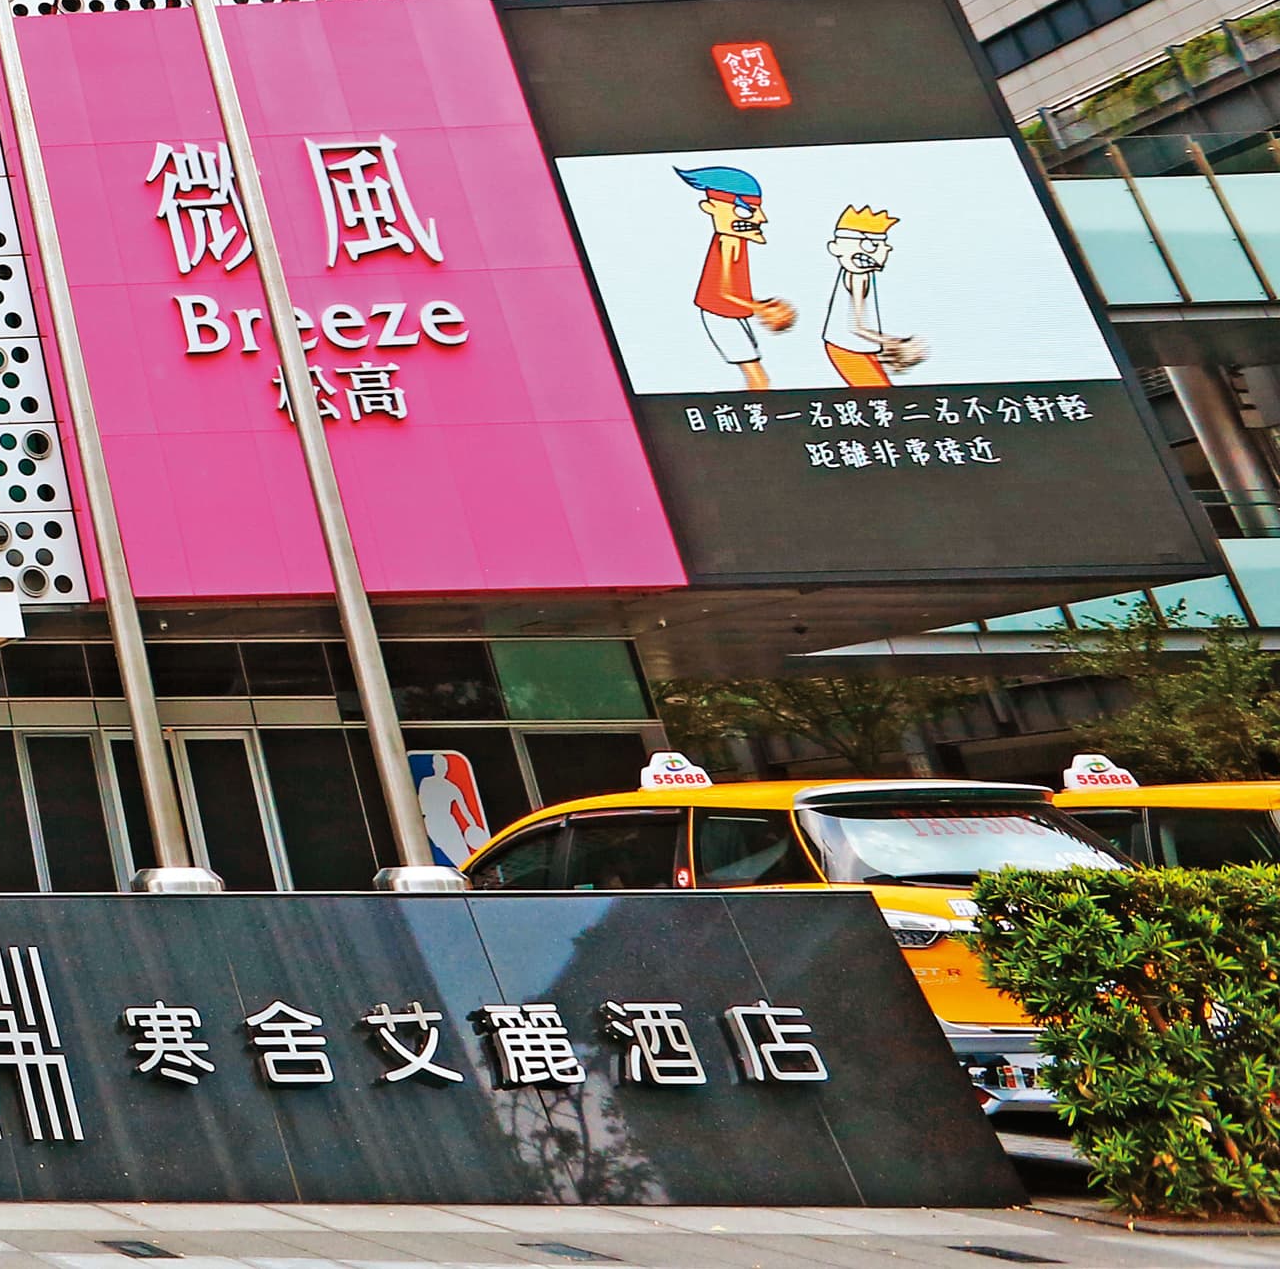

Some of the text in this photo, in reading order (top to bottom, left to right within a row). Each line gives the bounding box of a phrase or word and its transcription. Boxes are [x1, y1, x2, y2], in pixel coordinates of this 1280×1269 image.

[145, 134, 445, 275] 微風
[172, 294, 470, 355] Breeze
[804, 437, 1001, 469] 距離非常接近
[653, 773, 707, 785] 55688
[1076, 774, 1132, 785] 55688
[124, 998, 830, 1086] 寒舍艾麗酒店
